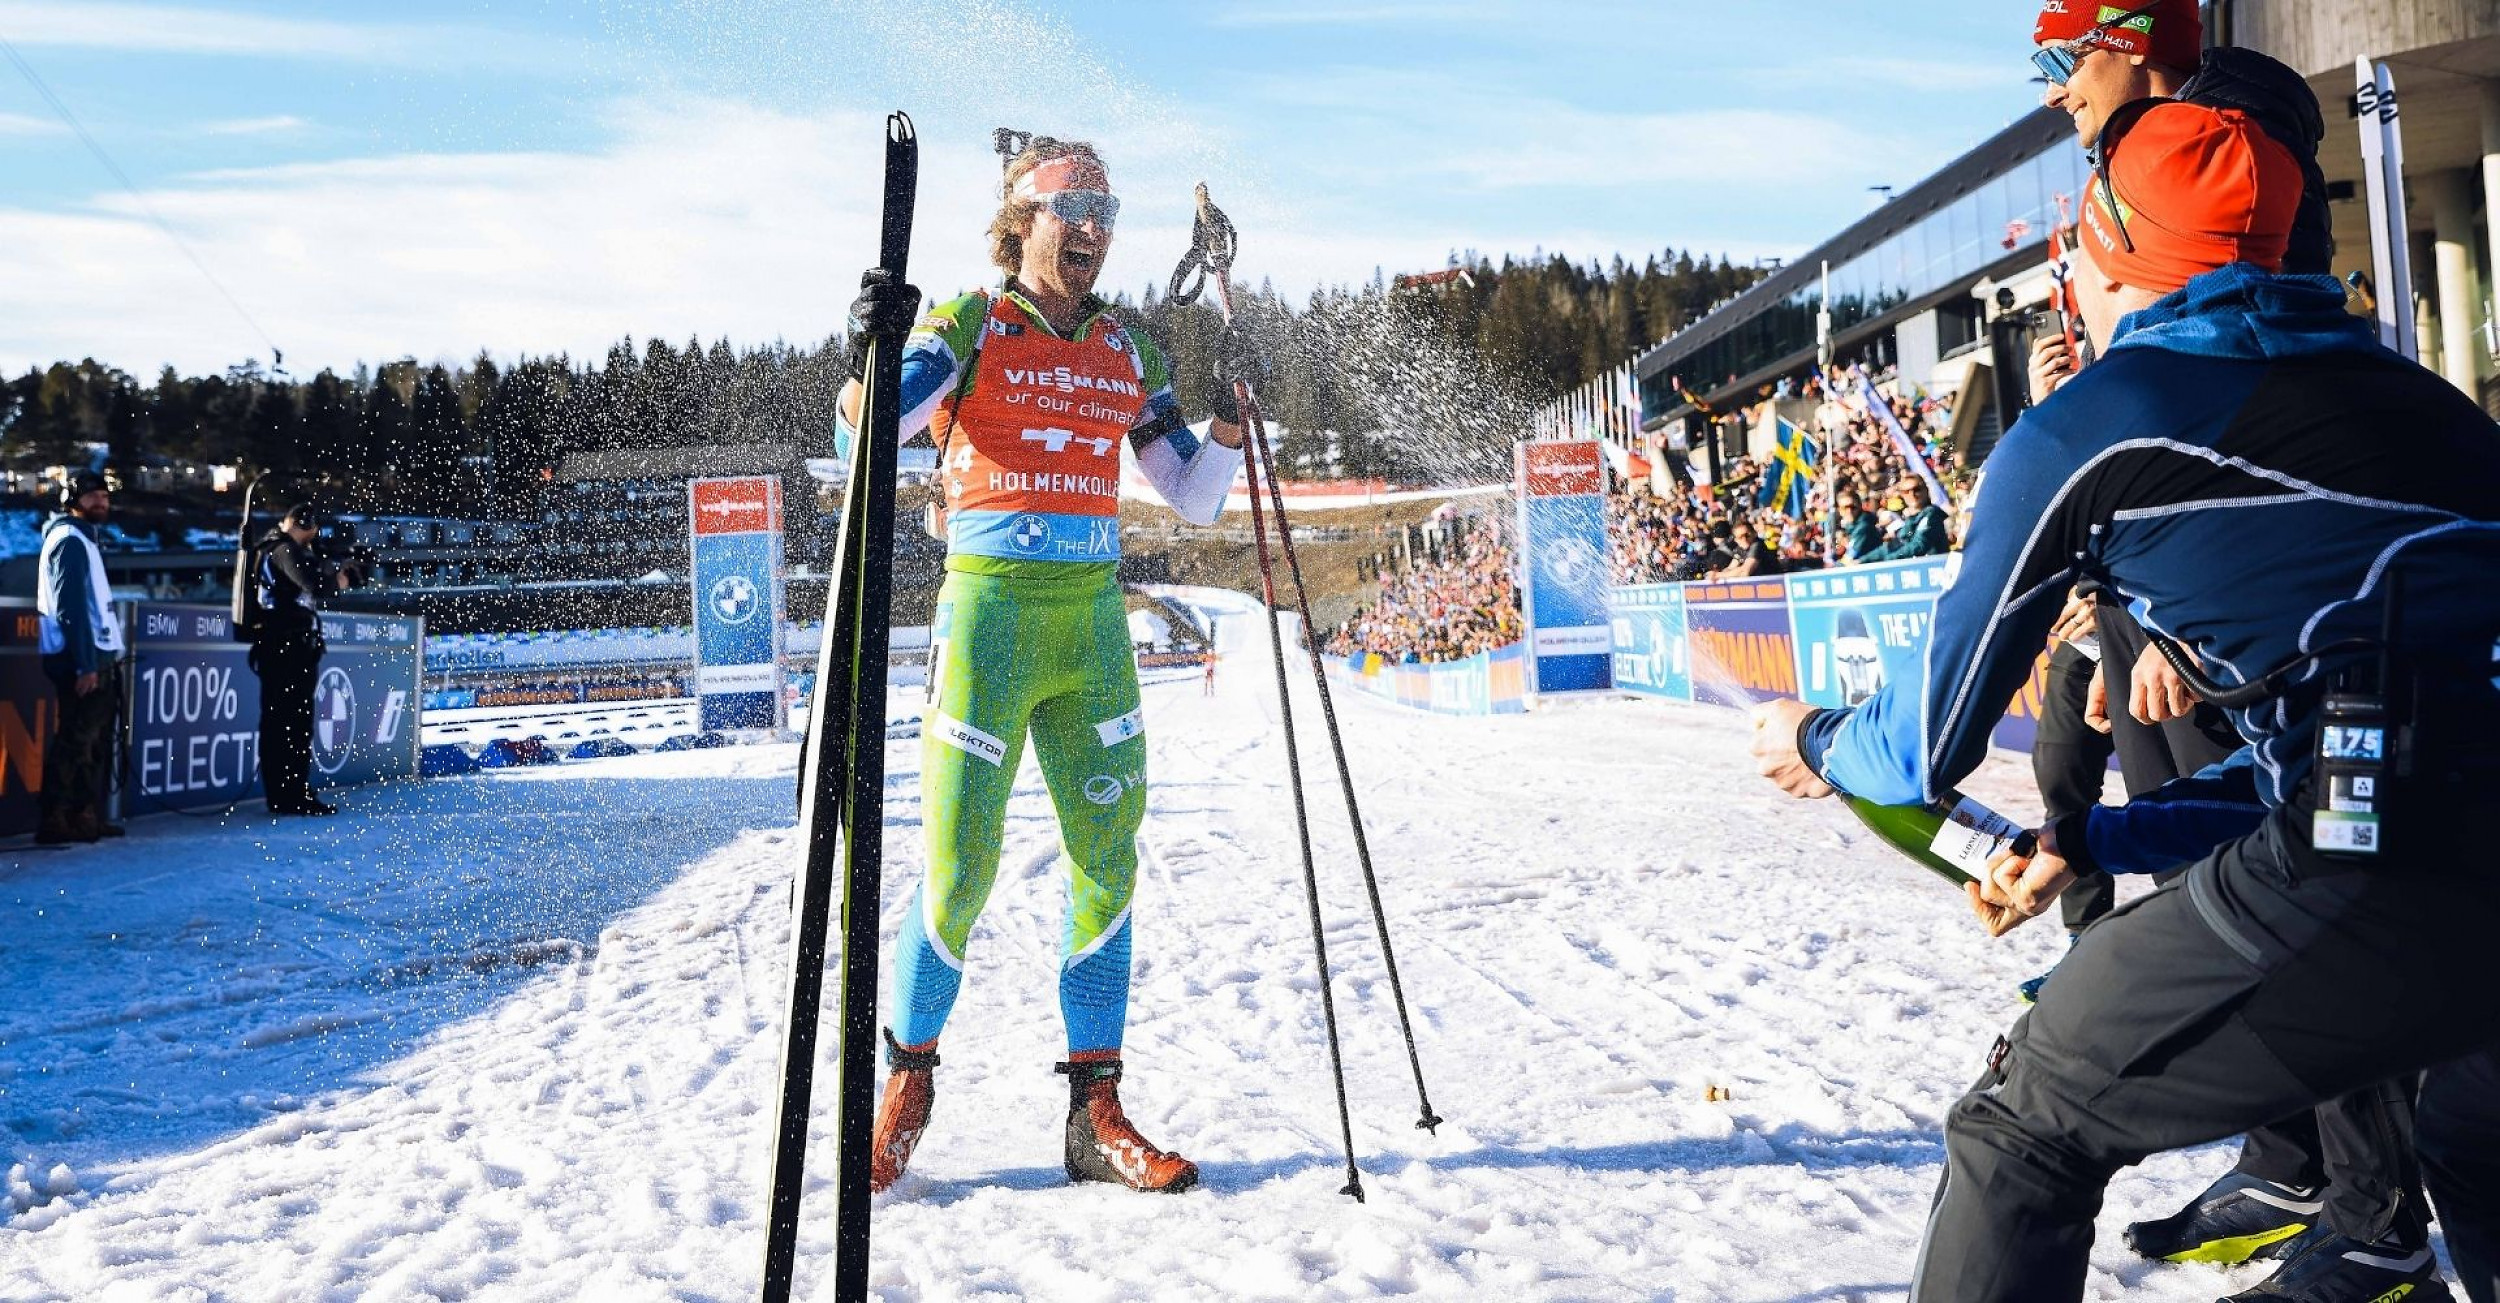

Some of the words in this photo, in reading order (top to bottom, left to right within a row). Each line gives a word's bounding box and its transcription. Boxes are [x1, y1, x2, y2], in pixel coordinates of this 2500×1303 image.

[2104, 34, 2134, 50] HALTI
[1004, 366, 1139, 397] VIESSMANN
[1037, 394, 1073, 413] our
[1055, 540, 1086, 555] THE
[1089, 520, 1112, 555] iX
[147, 615, 179, 635] BMW
[197, 617, 226, 637] BMW
[1879, 613, 1911, 647] THE
[143, 667, 237, 724] 100%
